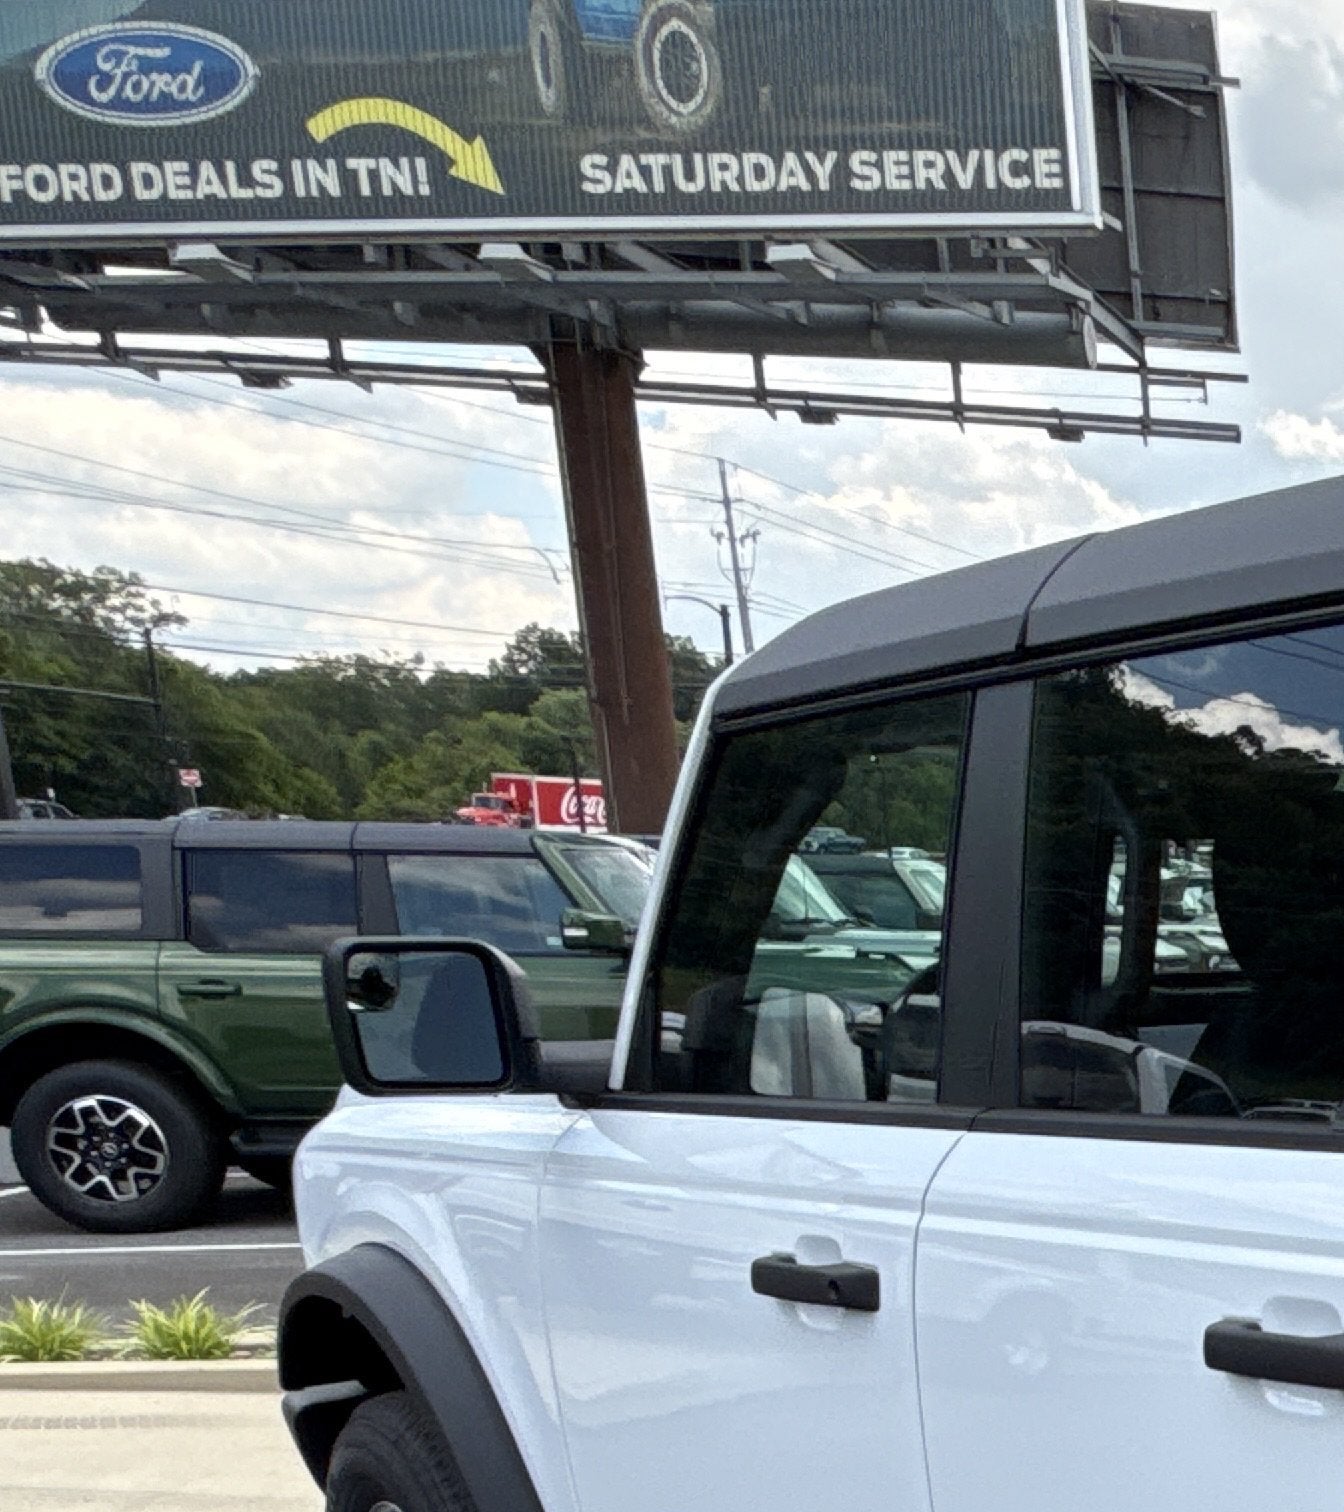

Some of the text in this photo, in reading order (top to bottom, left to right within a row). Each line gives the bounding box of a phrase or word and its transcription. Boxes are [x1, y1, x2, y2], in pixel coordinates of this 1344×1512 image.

[88, 42, 205, 103] Ford
[0, 155, 431, 203] FORD DEALS IN TN!
[580, 147, 1064, 194] SATURDAY SERVICE
